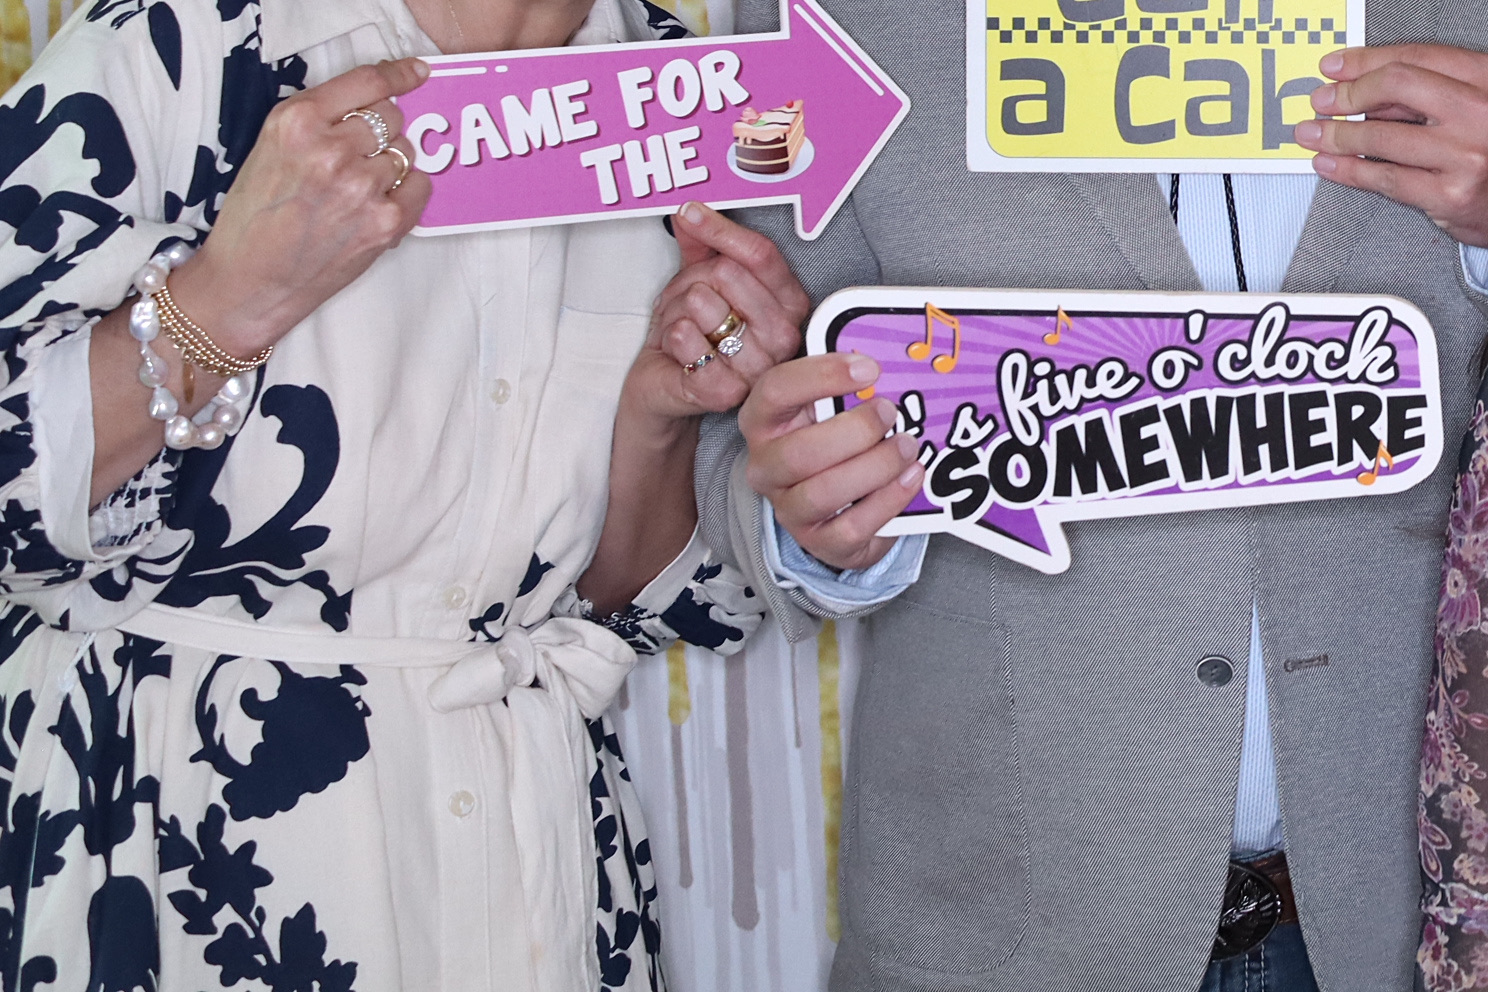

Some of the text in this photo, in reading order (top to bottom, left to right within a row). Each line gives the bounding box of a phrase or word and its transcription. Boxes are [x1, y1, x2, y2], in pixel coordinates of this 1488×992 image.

[406, 50, 750, 174] CAME FOR
[1000, 44, 1333, 150] a Cab
[580, 126, 709, 205] THE
[998, 349, 1140, 429] five
[1150, 303, 1399, 391] o'clock
[931, 394, 1429, 520] SOMEWHERE
